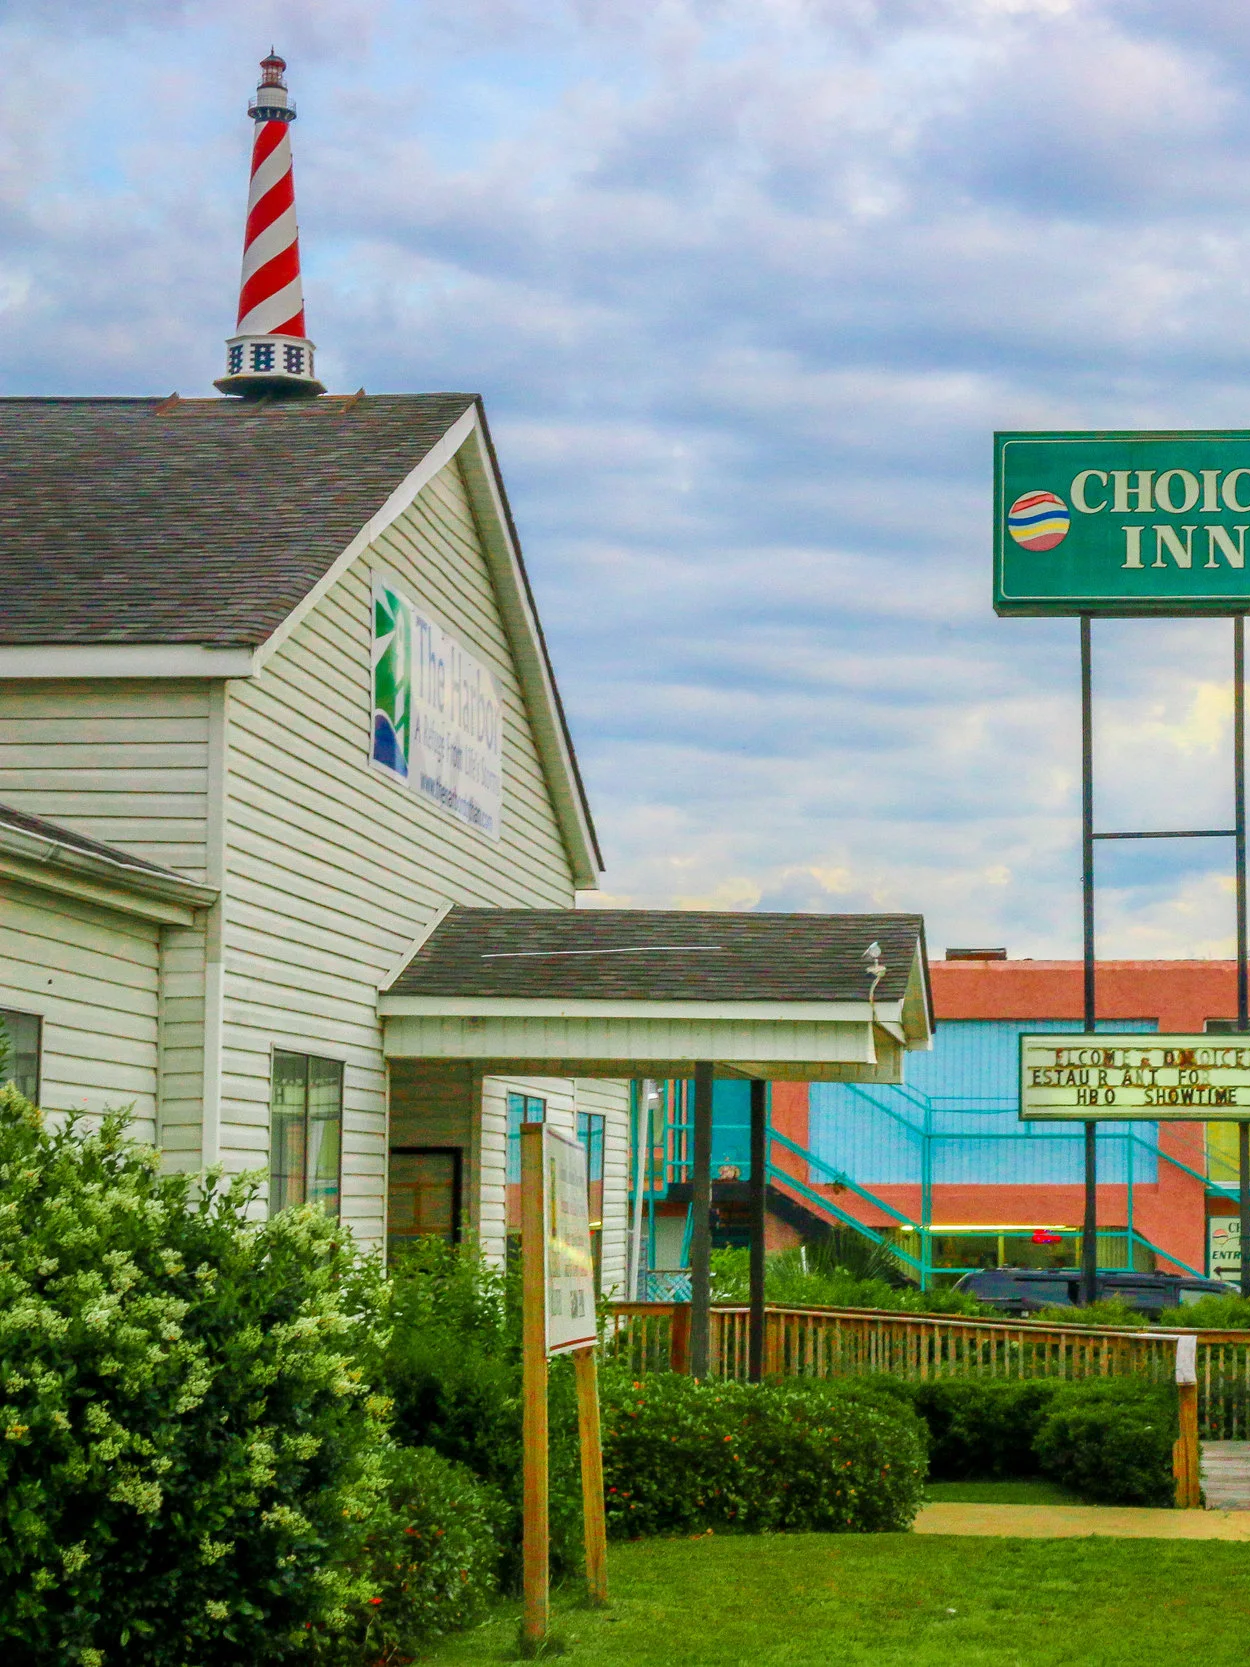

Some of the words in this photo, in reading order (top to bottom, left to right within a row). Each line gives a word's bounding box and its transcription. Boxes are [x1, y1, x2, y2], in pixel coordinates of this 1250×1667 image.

[1120, 525, 1250, 569] INN
[416, 616, 445, 712] The
[451, 646, 500, 756] Harbor
[1077, 1088, 1115, 1105] HBO
[1144, 1088, 1237, 1106] SHOWTIME
